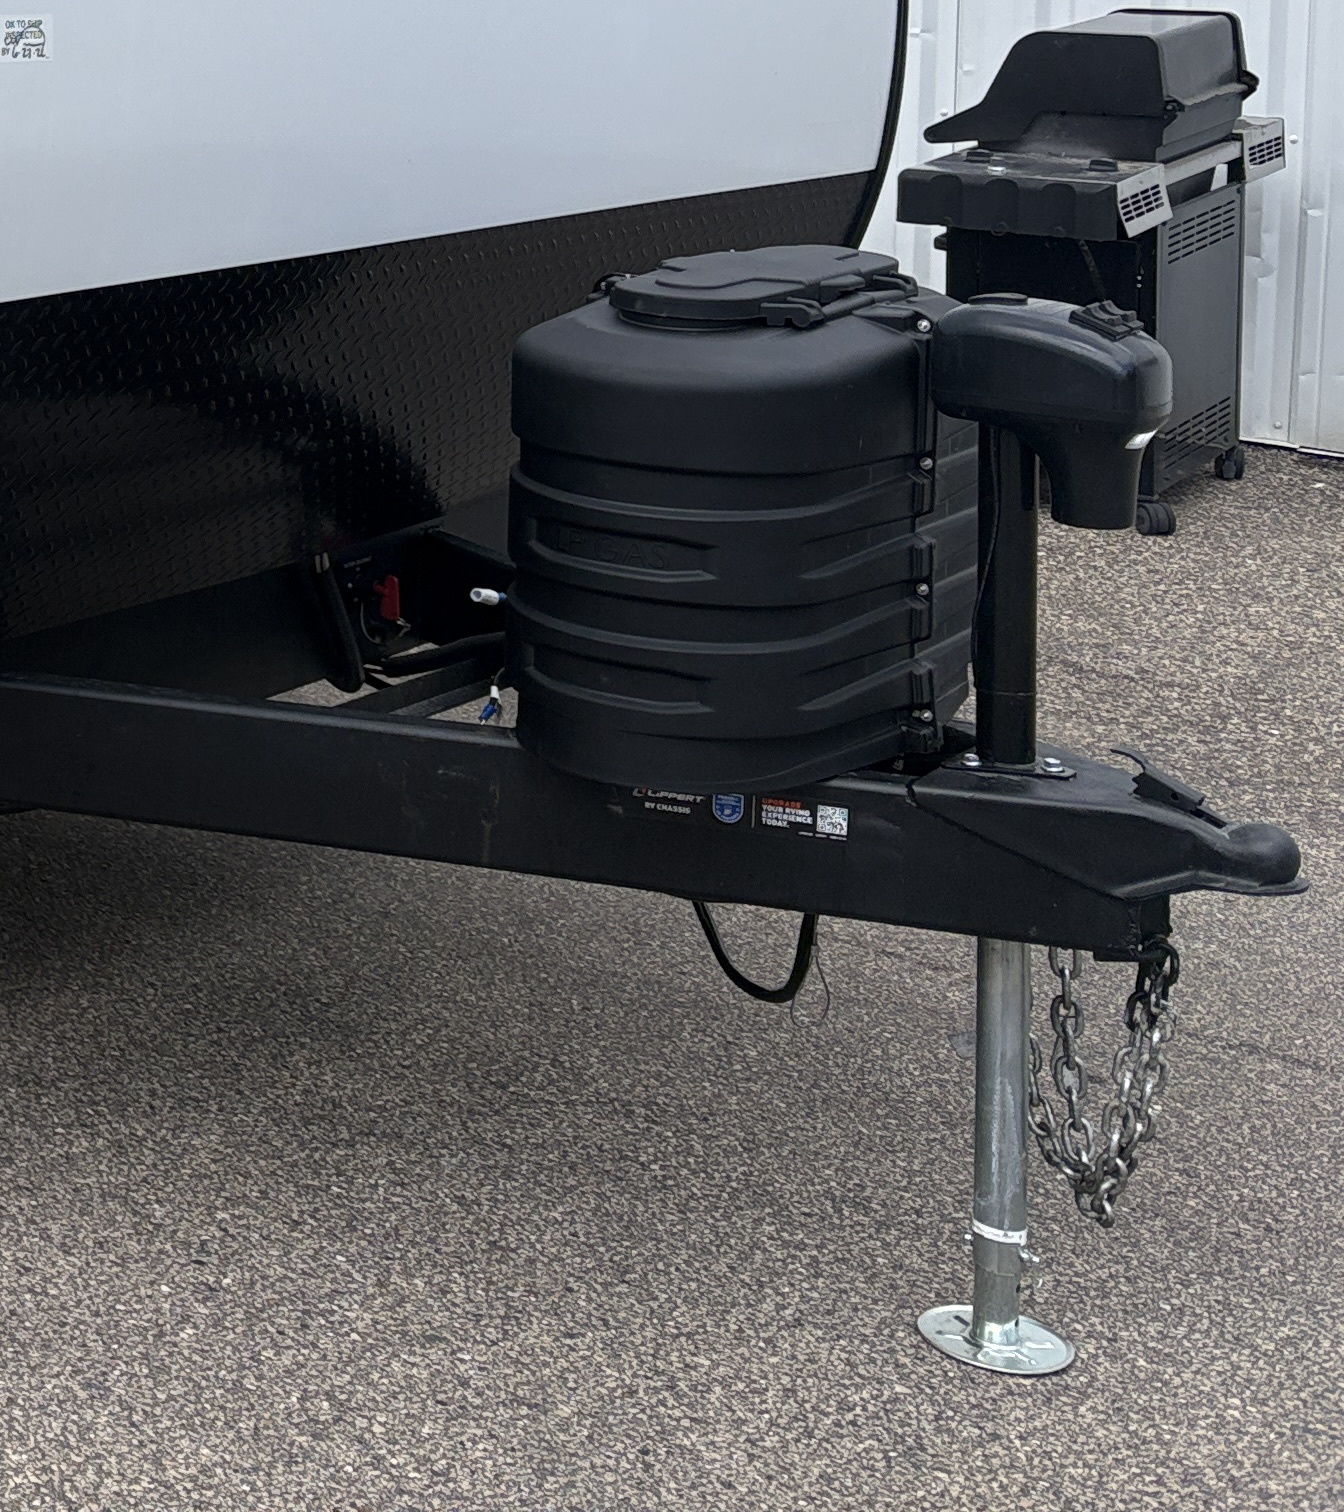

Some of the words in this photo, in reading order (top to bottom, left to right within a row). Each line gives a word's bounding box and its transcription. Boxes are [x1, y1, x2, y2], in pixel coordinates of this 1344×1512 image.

[593, 534, 669, 570] GAS
[656, 803, 692, 815] CHASSIS
[761, 804, 784, 813] YOUR
[761, 810, 813, 825] EXPERIENCE
